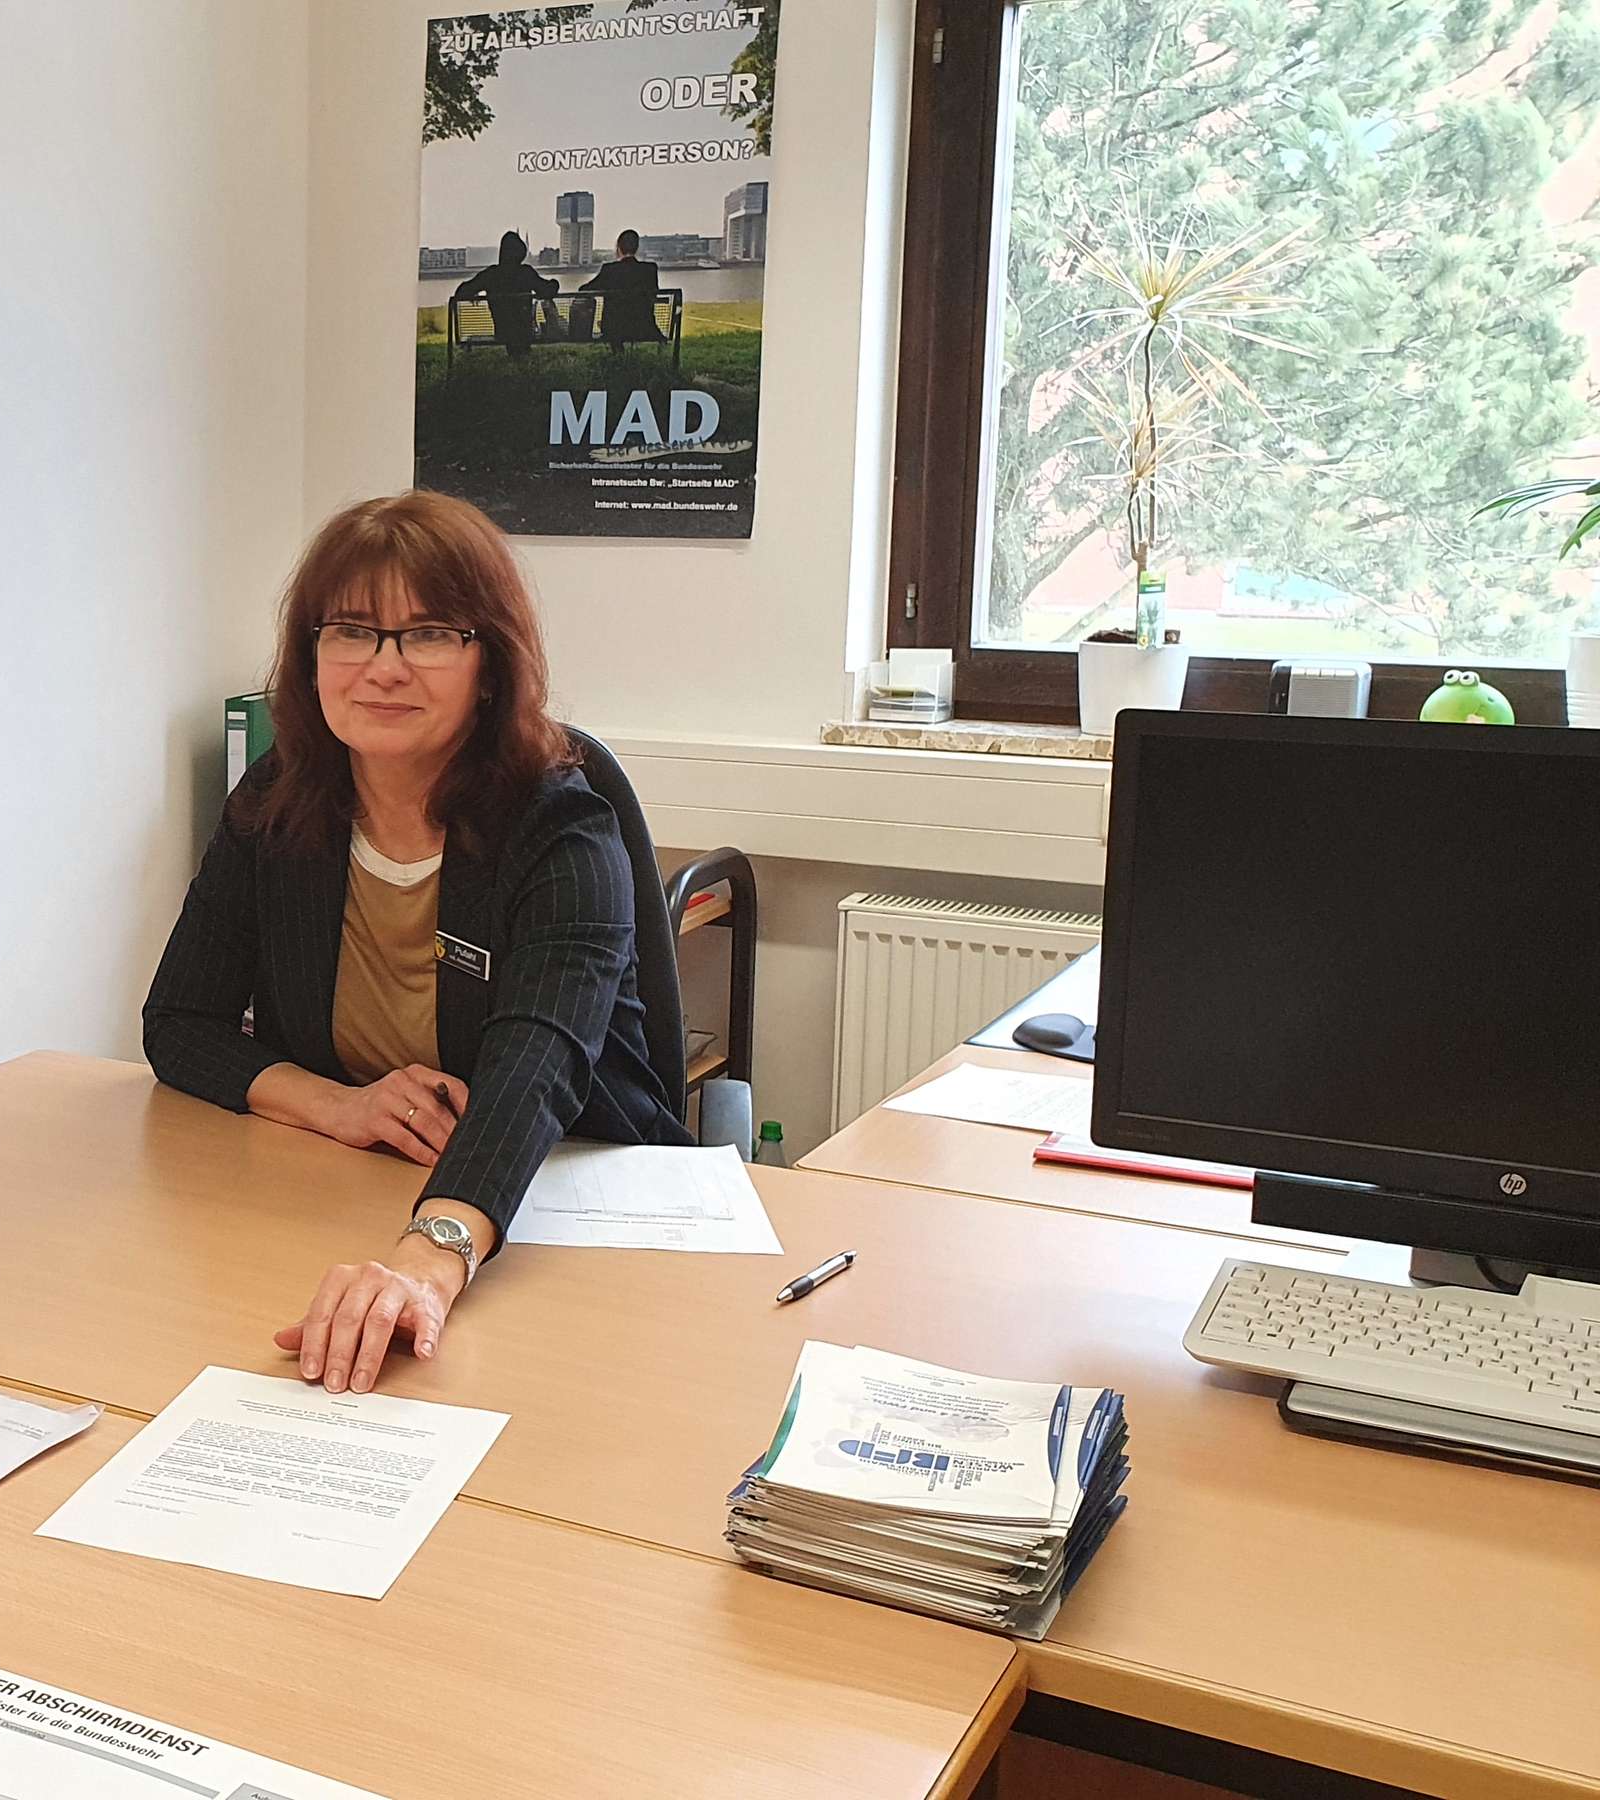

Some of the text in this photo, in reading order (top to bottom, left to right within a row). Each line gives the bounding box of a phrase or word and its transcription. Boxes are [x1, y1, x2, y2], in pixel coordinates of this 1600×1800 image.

[439, 7, 765, 54] ZUFALLSBEKANNTSCHAFT
[640, 73, 758, 111] ODER
[517, 139, 754, 173] KONTAKTPERSON?
[549, 389, 720, 445] MAD
[591, 478, 648, 487] Intranetsuche
[649, 479, 666, 488] Bw:
[671, 462, 723, 471] Bundeswehr
[594, 501, 739, 511] Internet: www.mad.bundeswehr.de
[1501, 1173, 1526, 1196] hp
[17, 1689, 210, 1756] ABSCHIRMDIENST
[26, 1710, 49, 1724] für
[50, 1717, 73, 1731] die
[73, 1725, 164, 1761] Bundeswehr
